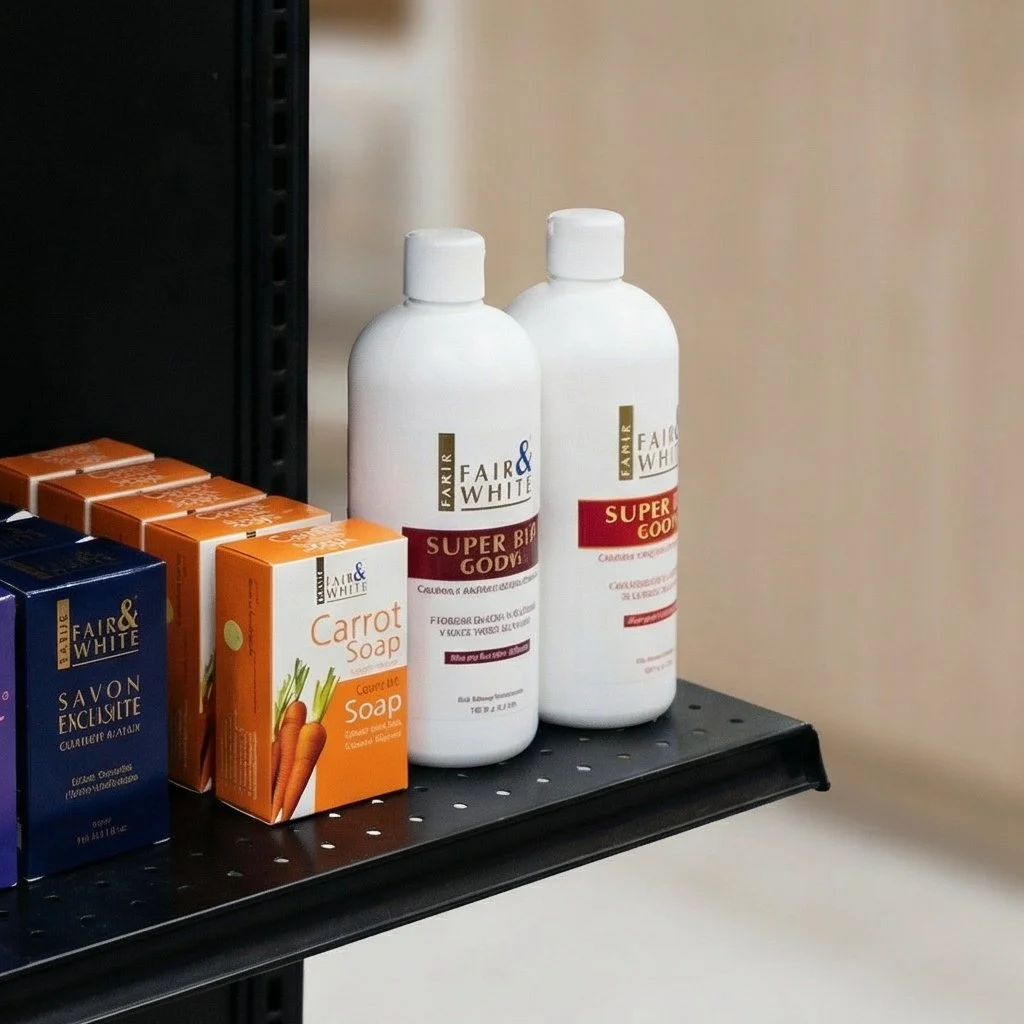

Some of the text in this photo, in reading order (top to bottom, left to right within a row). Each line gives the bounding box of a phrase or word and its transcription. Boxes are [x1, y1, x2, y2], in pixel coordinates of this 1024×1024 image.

[460, 475, 532, 505] WHITE
[605, 497, 670, 524] SUPER
[426, 533, 506, 556] SUPER
[326, 581, 367, 599] WHITE
[310, 601, 402, 646] Carrot
[73, 629, 139, 660] WHITE
[346, 635, 401, 663] Soap
[58, 674, 140, 712] SAVON
[344, 692, 403, 725] Soap
